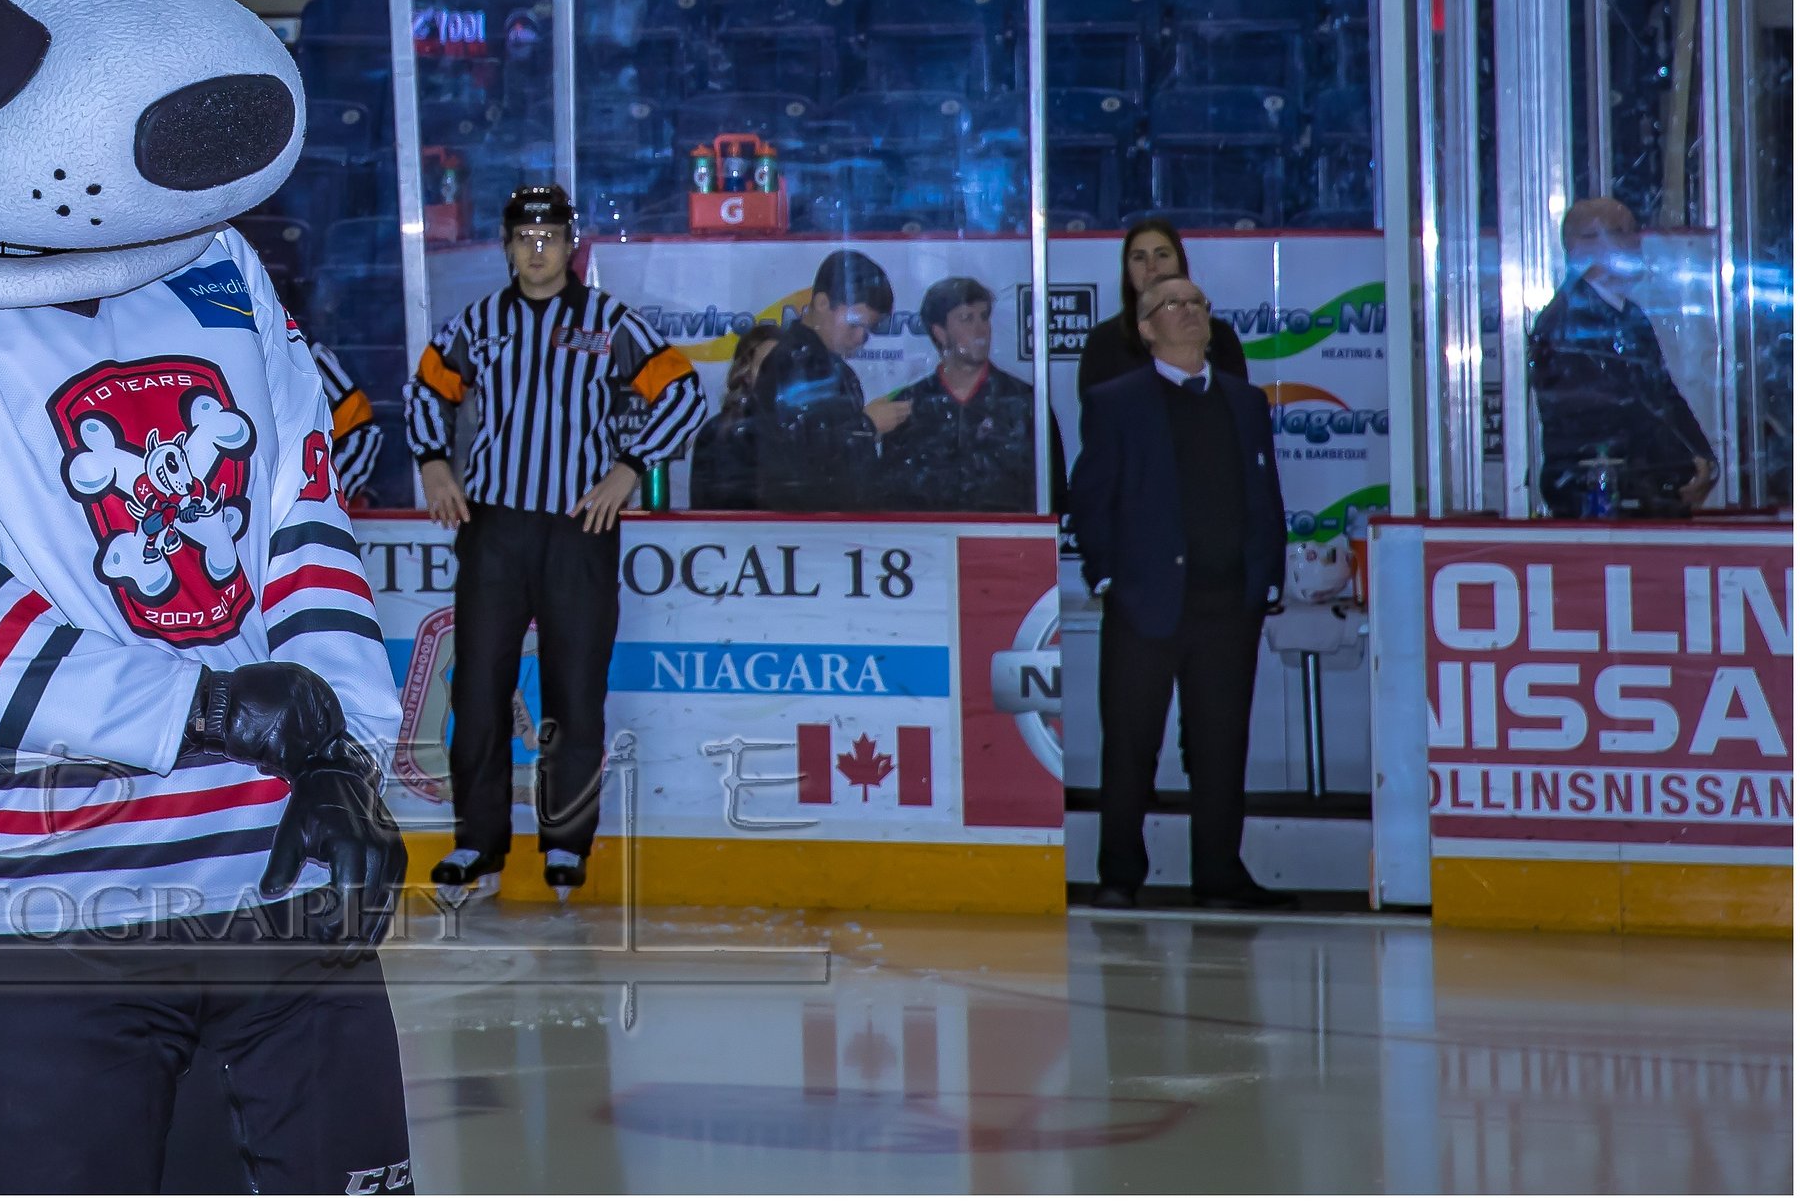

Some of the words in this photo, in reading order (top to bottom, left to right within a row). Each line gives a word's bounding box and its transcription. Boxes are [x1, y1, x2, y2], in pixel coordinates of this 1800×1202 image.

[1321, 348, 1372, 360] HEATING
[84, 386, 112, 407] 10
[114, 374, 193, 393] YEARS
[843, 548, 914, 598] 18
[143, 609, 205, 626] 2007
[649, 650, 890, 693] NIAGARA
[345, 1159, 412, 1196] CC
